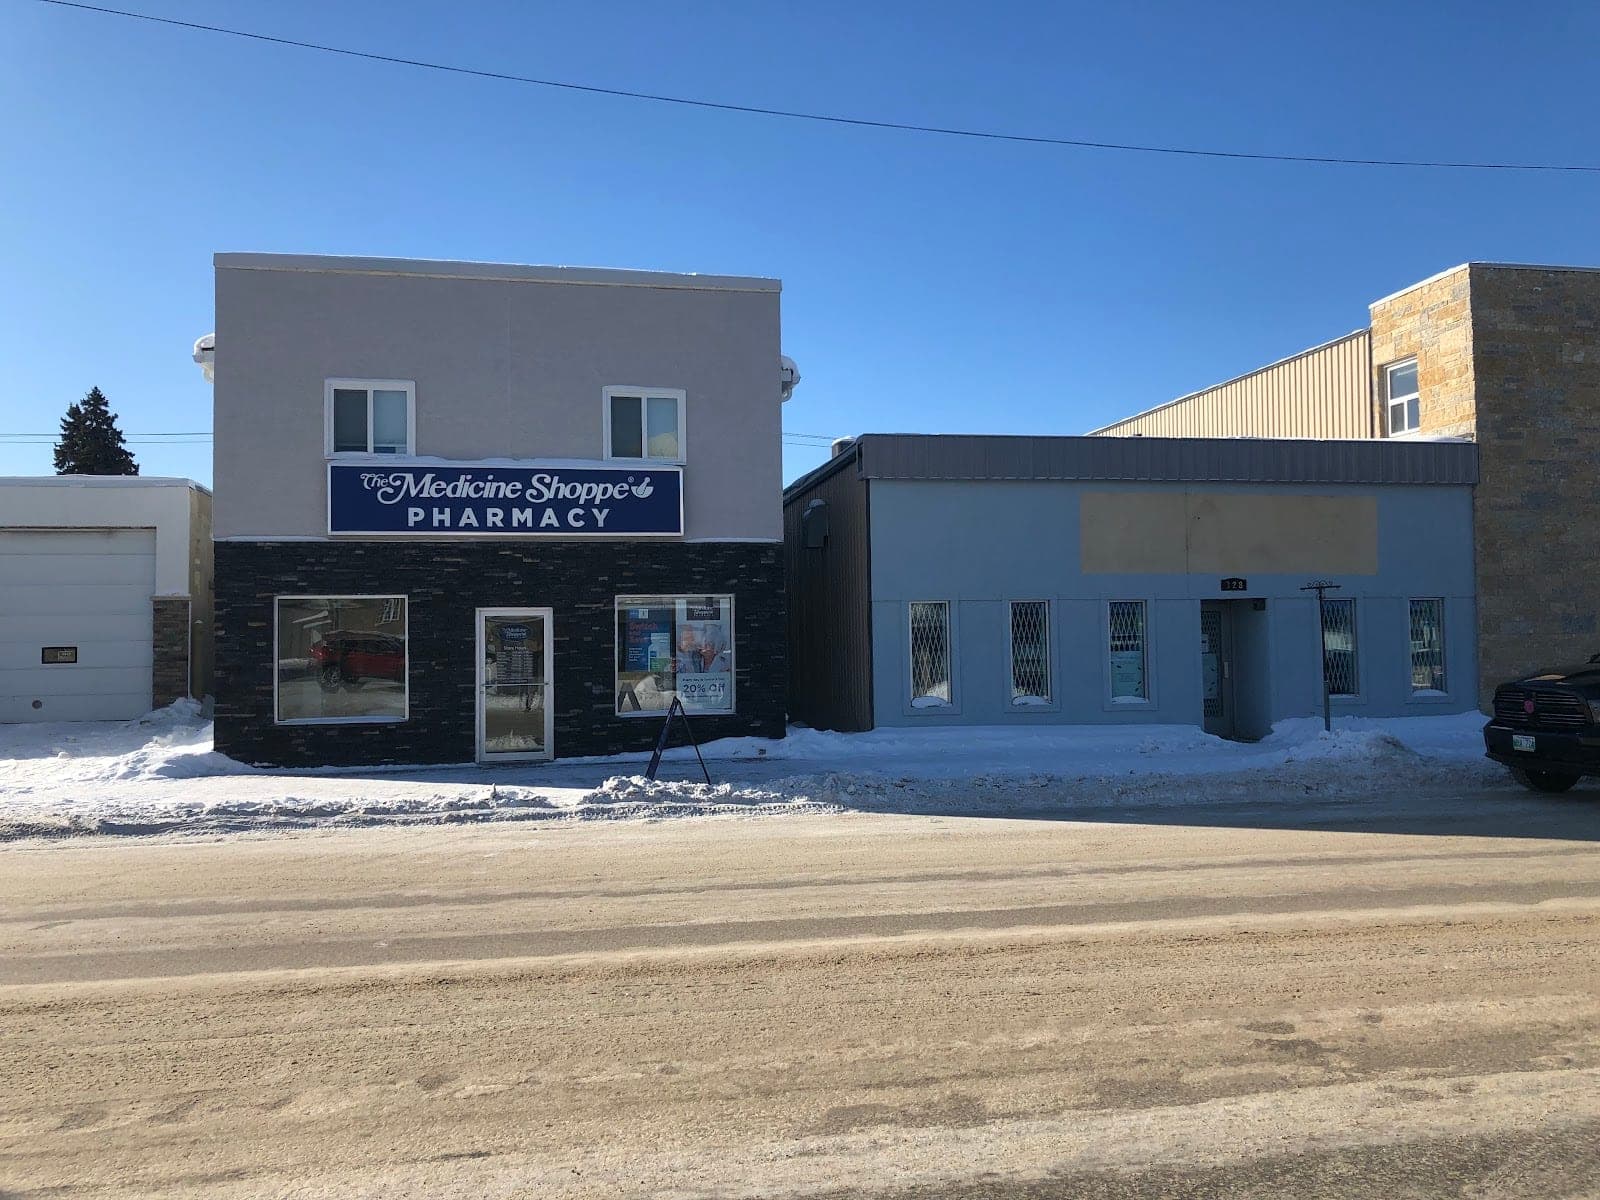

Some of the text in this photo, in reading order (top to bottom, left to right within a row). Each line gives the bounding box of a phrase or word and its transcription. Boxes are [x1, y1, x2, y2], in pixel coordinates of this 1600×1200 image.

[360, 472, 629, 504] The Medicine Shoppe
[407, 507, 611, 527] PHARMACY
[683, 683, 725, 693] 20% Off
